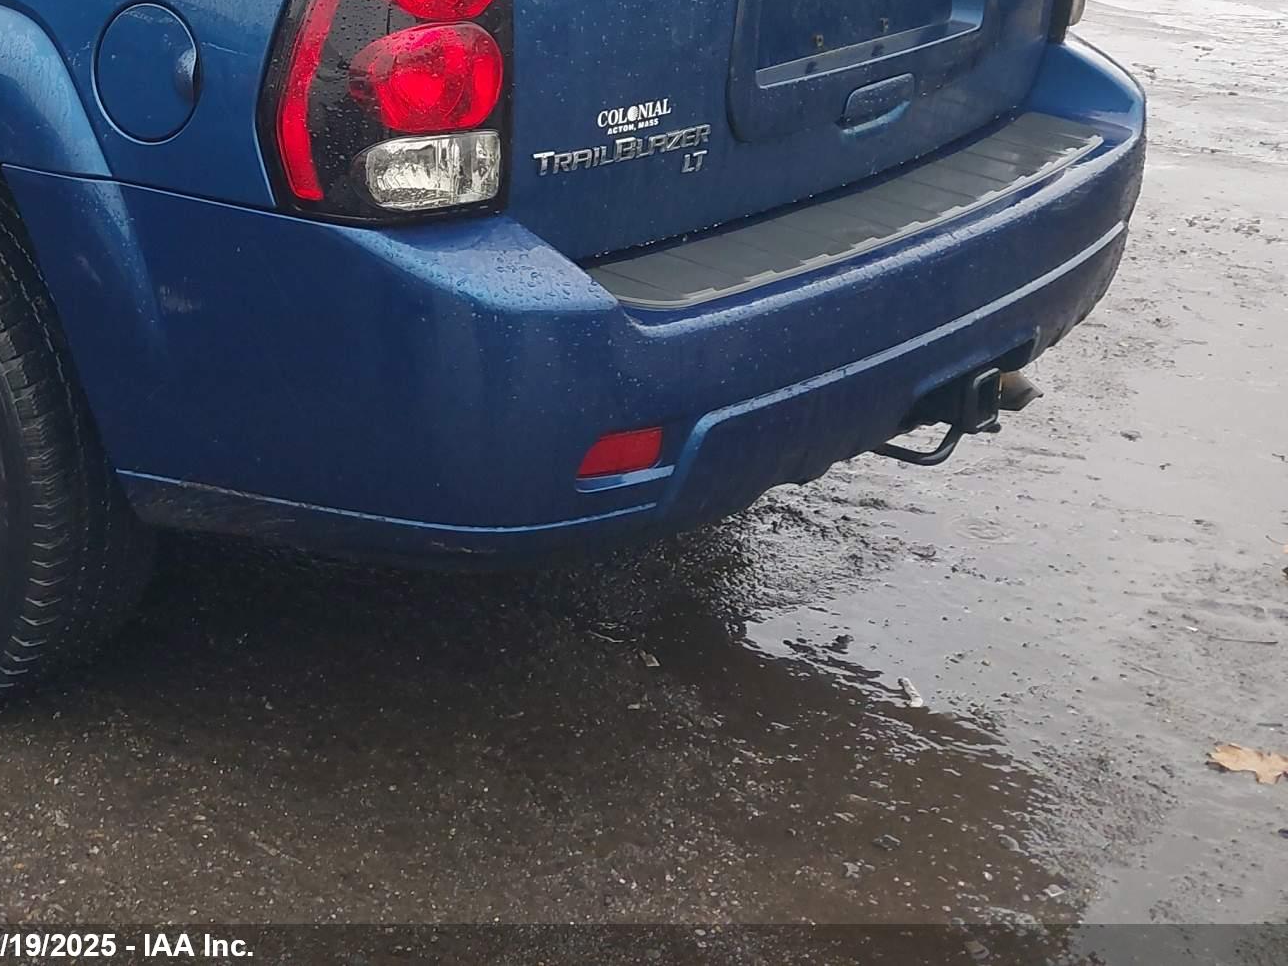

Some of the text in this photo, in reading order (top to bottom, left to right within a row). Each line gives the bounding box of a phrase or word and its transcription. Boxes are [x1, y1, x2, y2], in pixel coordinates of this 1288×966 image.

[597, 98, 672, 128] COLONIAL
[638, 118, 659, 131] MASS
[681, 150, 708, 174] LT
